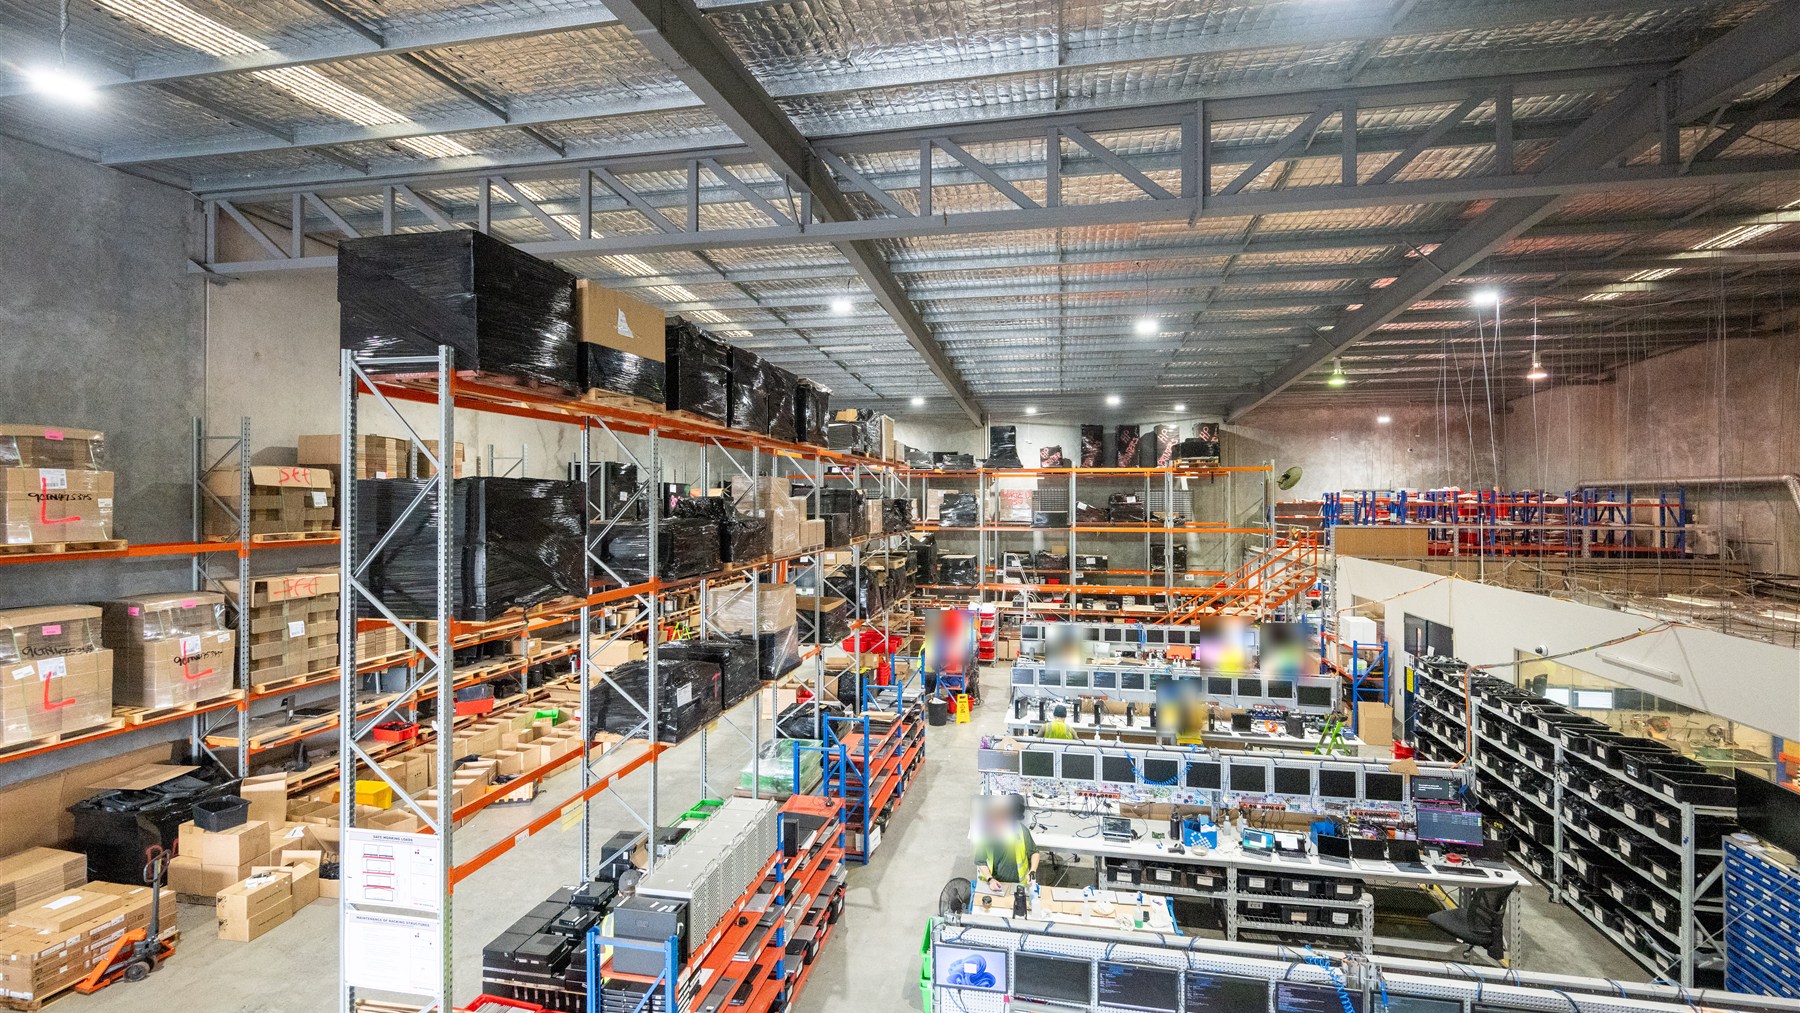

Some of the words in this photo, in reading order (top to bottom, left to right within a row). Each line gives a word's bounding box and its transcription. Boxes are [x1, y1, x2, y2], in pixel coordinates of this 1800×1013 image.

[1157, 428, 1169, 444] HP
[41, 477, 81, 525] L
[184, 640, 213, 681] L
[43, 671, 76, 710] L
